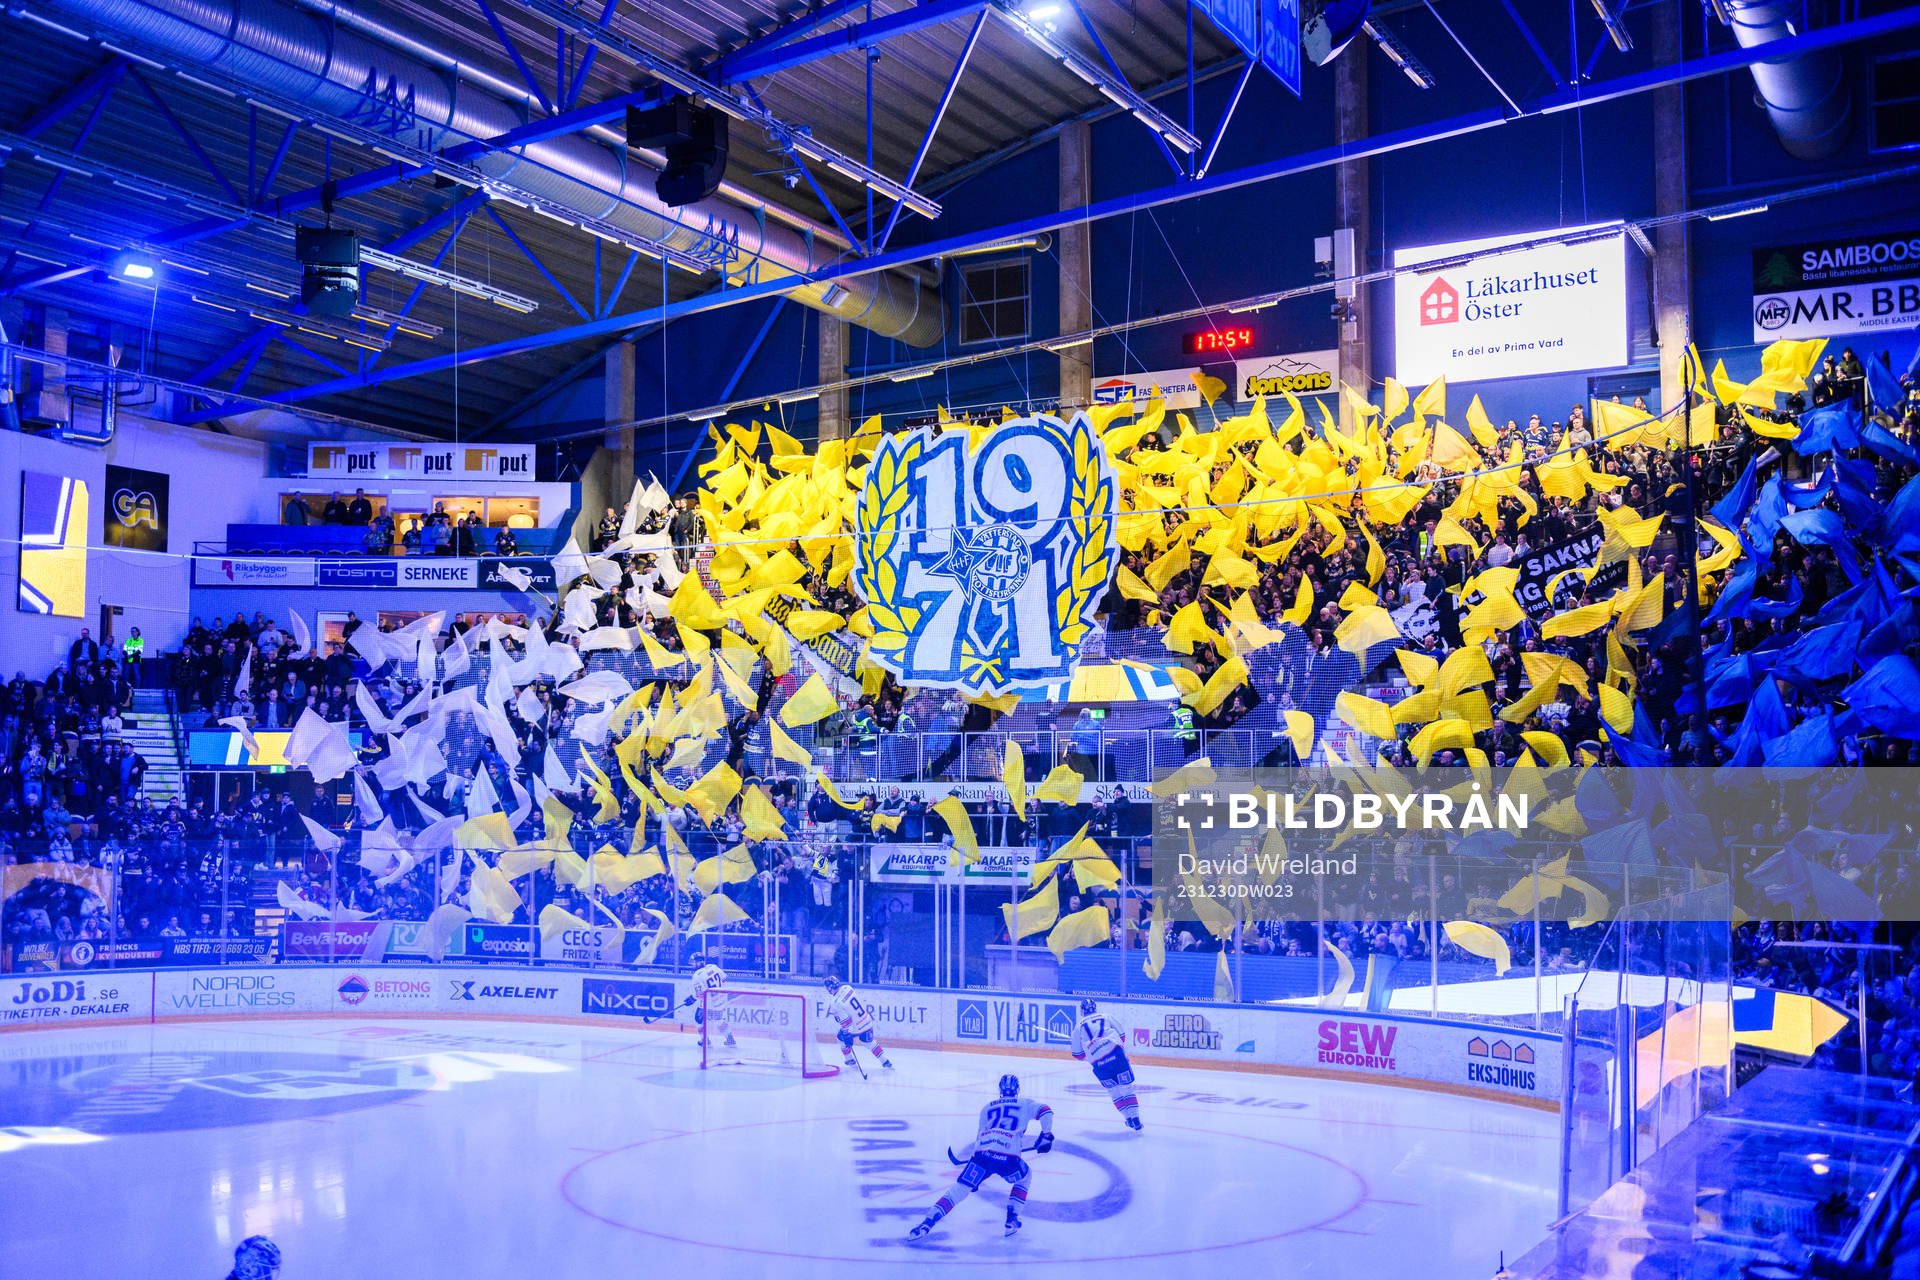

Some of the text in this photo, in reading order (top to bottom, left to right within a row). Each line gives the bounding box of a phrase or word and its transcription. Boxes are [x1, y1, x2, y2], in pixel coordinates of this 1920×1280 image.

[1264, 18, 1297, 79] 2017
[1466, 267, 1598, 299] Läkarhuset
[1464, 300, 1523, 322] Öster
[1791, 292, 1864, 325] MR.
[1858, 317, 1889, 328] MIDDLE
[1196, 331, 1250, 350] 17:54
[1452, 349, 1464, 358] En
[1467, 346, 1484, 356] del
[1488, 345, 1500, 353] av
[1504, 340, 1535, 352] Prima
[1186, 382, 1198, 394] AB
[1246, 370, 1332, 397] Jonsons
[906, 422, 1072, 556] 19
[1526, 533, 1605, 576] SAKNA
[234, 562, 287, 574] Riksbyggen
[322, 568, 395, 578] TOSITO
[404, 567, 468, 581] SERNEKE
[1527, 600, 1549, 613] 1980
[900, 553, 1064, 682] 71
[889, 854, 947, 865] HAKARPS
[99, 943, 139, 952] FRNCKS
[226, 943, 242, 954] 669
[244, 943, 254, 954] 23
[254, 943, 265, 954] 05
[12, 979, 119, 1004] JoDi .se
[192, 975, 275, 991] NORDIC
[374, 981, 431, 992] BETONG
[479, 985, 559, 1000] AXELENT
[171, 991, 296, 1009] WELLNESS
[842, 997, 855, 1016] 9
[71, 1003, 129, 1017] DEKALER
[816, 1002, 928, 1024] FARHULT
[964, 1016, 981, 1034] YLAB
[994, 1000, 1039, 1043] YLAB
[1081, 1018, 1105, 1041] 17
[1164, 1014, 1204, 1033] EURO
[1152, 1030, 1220, 1050] JACKPOT
[1317, 1019, 1398, 1057] SEW
[1317, 1050, 1397, 1071] EURODRIVE
[1467, 1062, 1536, 1091] EKSJÖHUS
[1171, 1090, 1311, 1111] Telia
